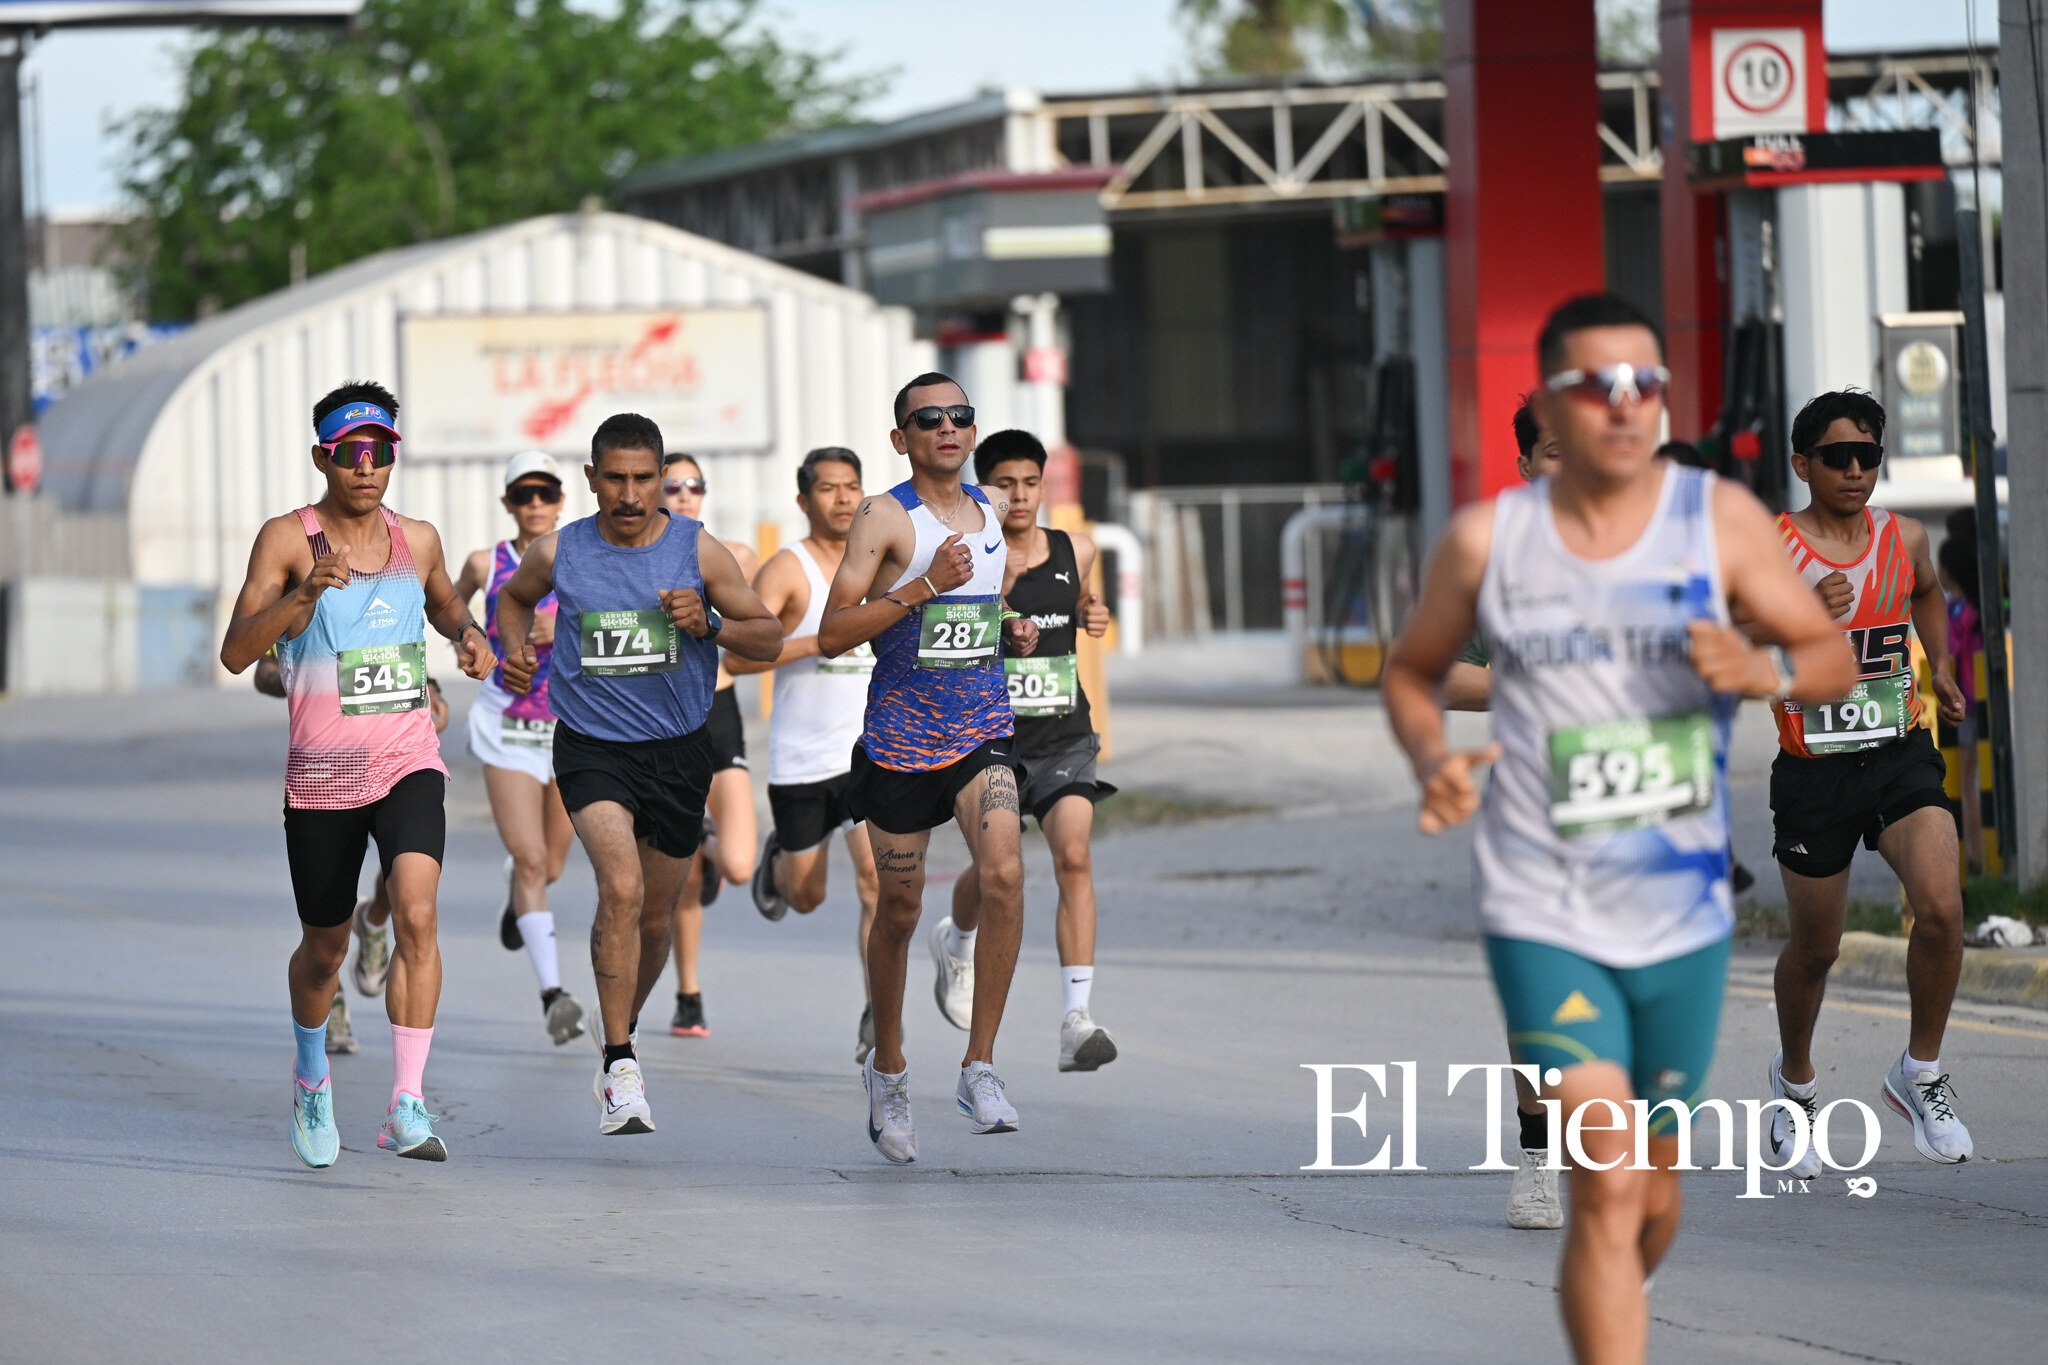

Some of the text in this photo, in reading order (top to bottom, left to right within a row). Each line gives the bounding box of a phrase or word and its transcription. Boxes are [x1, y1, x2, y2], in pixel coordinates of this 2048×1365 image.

[1740, 59, 1780, 89] 10
[494, 356, 541, 394] LA
[592, 628, 653, 656] 174
[668, 622, 677, 664] MEDALLA
[931, 621, 989, 648] 287
[361, 646, 400, 655] CARRERA
[353, 662, 413, 695] 545
[1007, 672, 1059, 698] 505
[1818, 700, 1882, 731] 190
[1896, 692, 1905, 738] MEDALLA
[1567, 743, 1675, 802] 595
